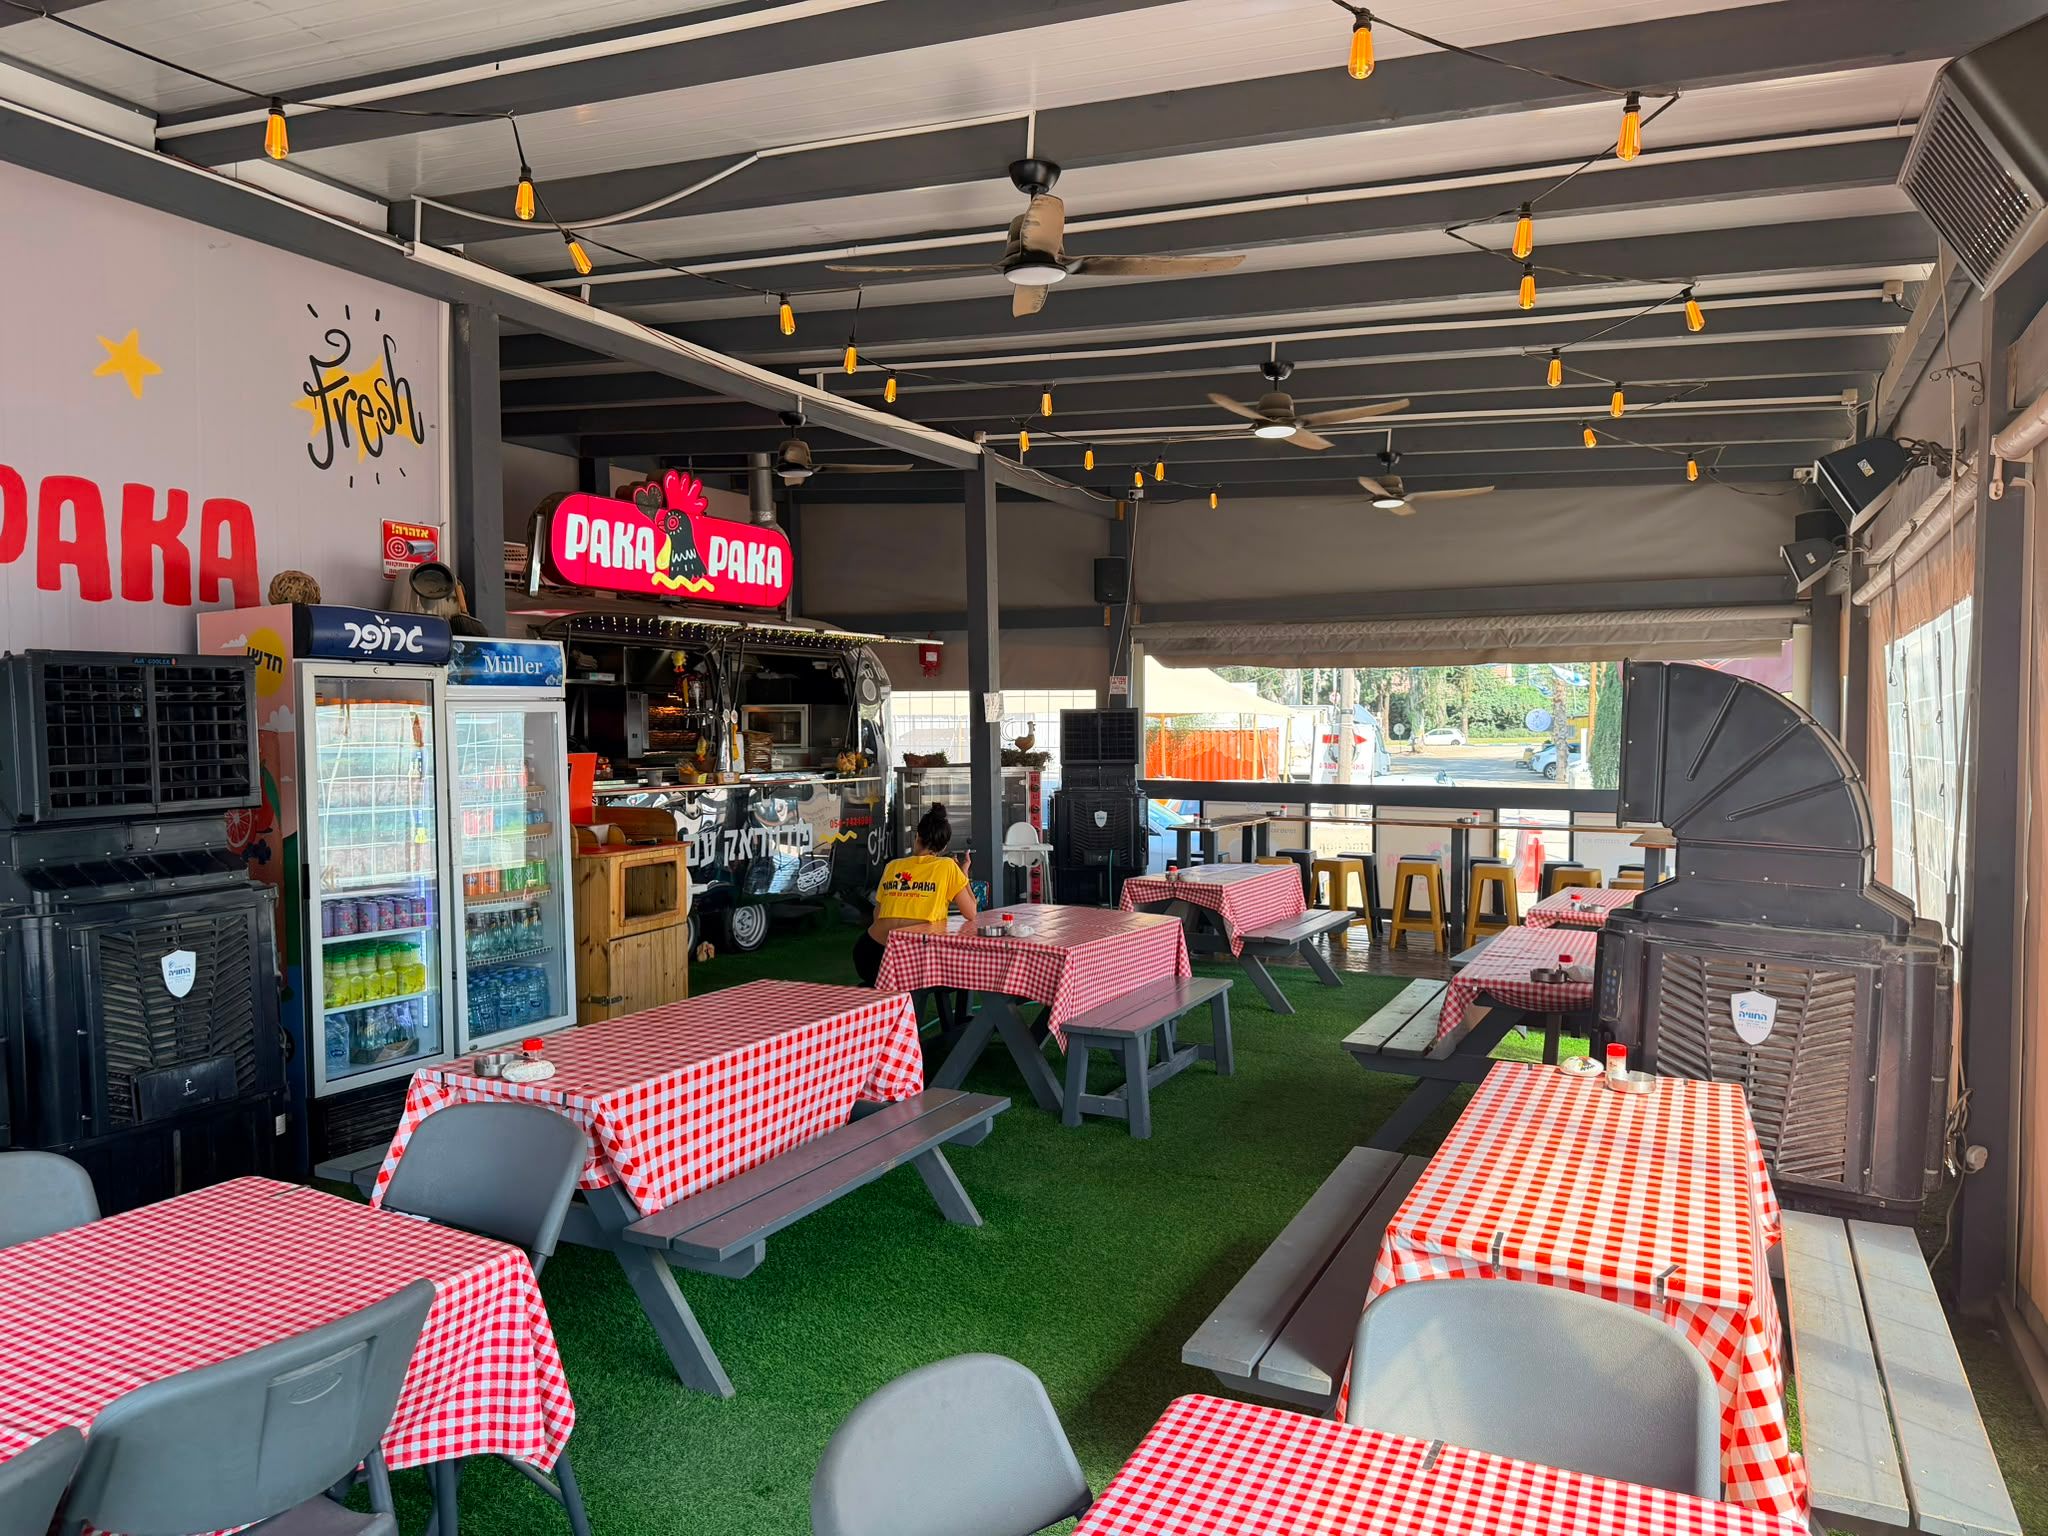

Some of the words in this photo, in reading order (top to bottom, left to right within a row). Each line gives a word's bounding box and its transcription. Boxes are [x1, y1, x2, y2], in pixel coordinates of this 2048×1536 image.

[303, 329, 424, 470] Fresh
[391, 523, 429, 539] אזהרה!
[564, 513, 656, 574] PAKA
[708, 535, 783, 588] PAKA
[482, 655, 544, 675] Müller
[912, 881, 936, 892] PAKA
